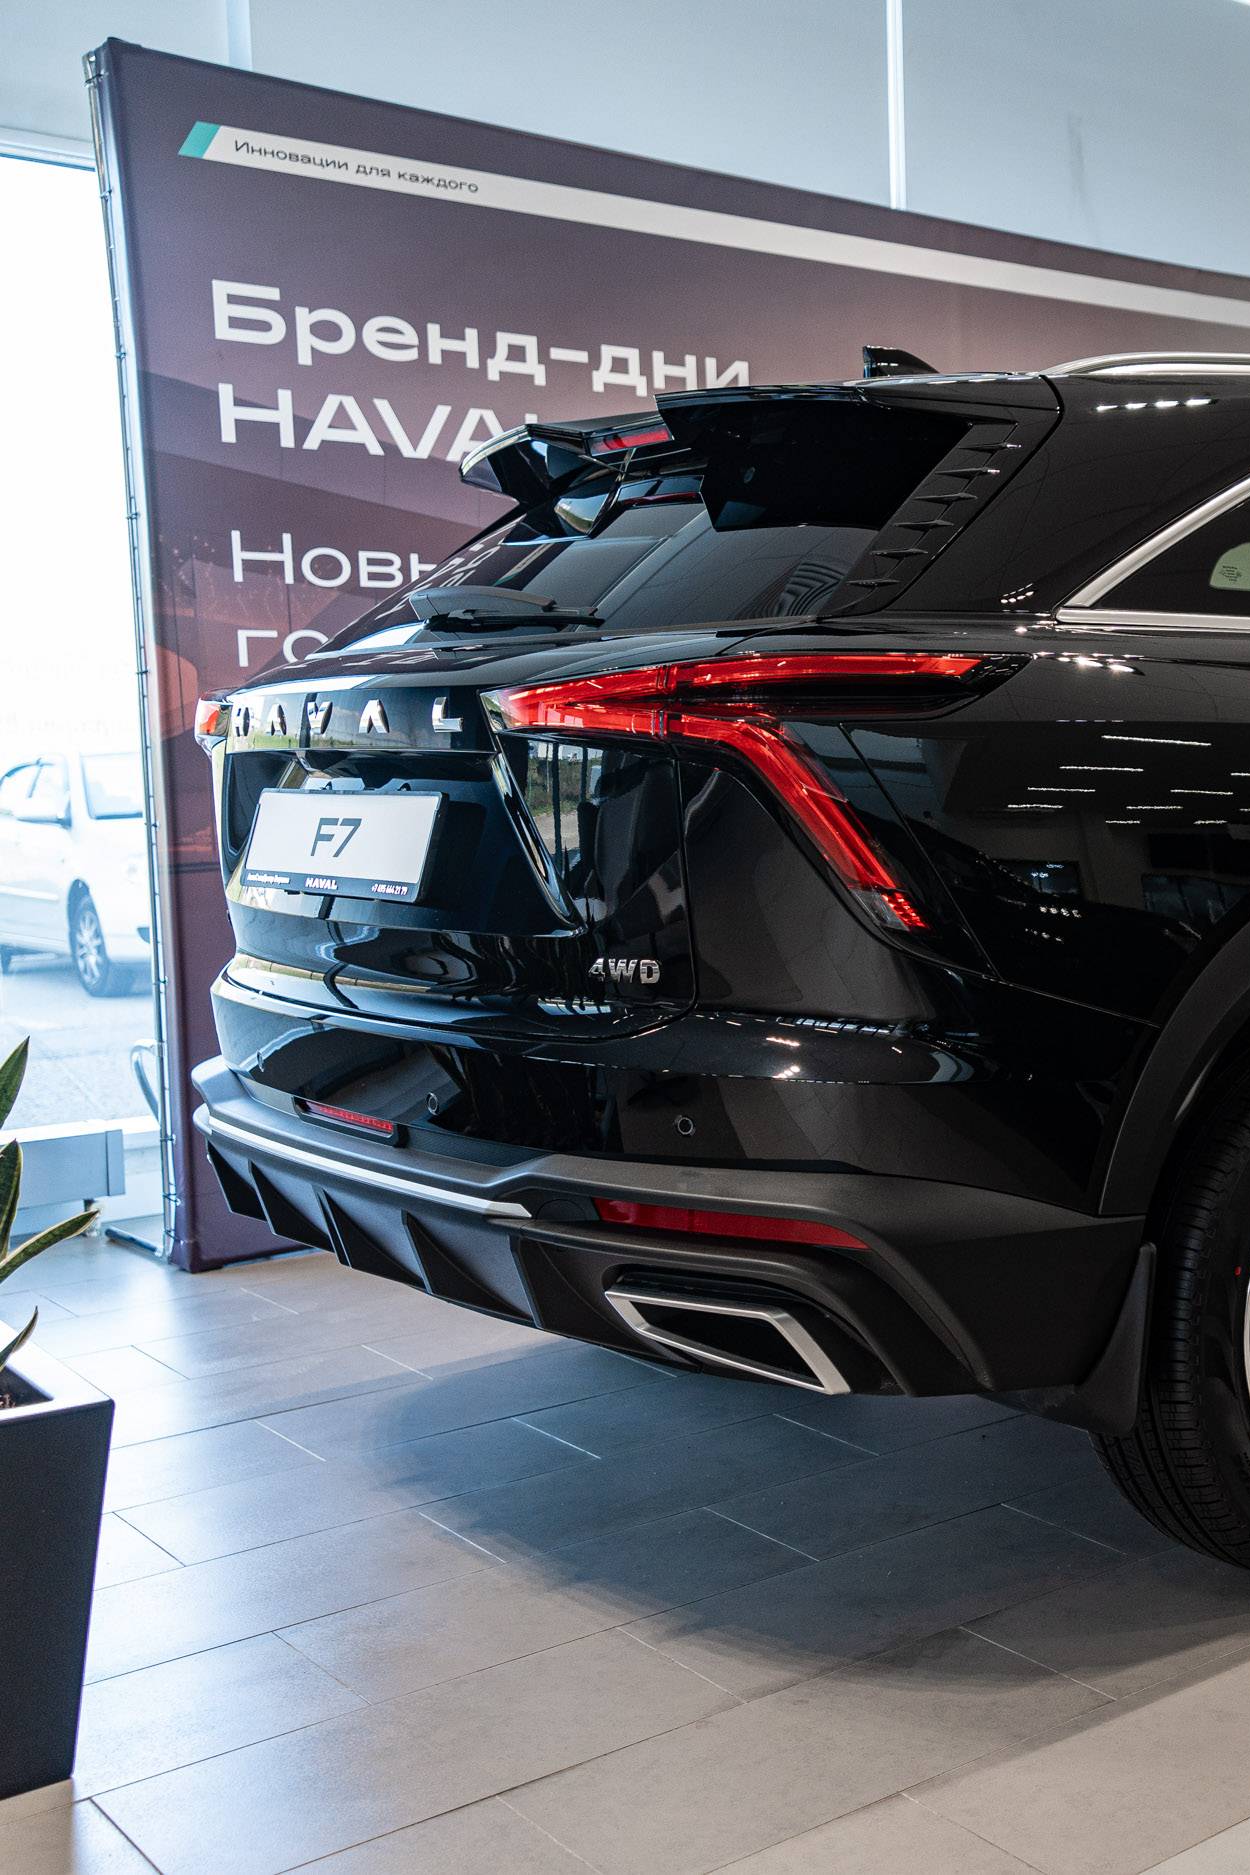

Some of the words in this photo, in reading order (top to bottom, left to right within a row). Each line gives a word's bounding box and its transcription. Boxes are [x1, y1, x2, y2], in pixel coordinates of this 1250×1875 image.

[234, 139, 349, 171] Инновации
[355, 162, 392, 177] для
[397, 170, 480, 194] каждого
[211, 278, 751, 397] Бренд-дни
[217, 382, 539, 462] HAVA
[231, 696, 464, 738] HAVAL
[310, 817, 363, 858] F7
[305, 876, 338, 891] HAVAL
[587, 958, 661, 984] 4WD
